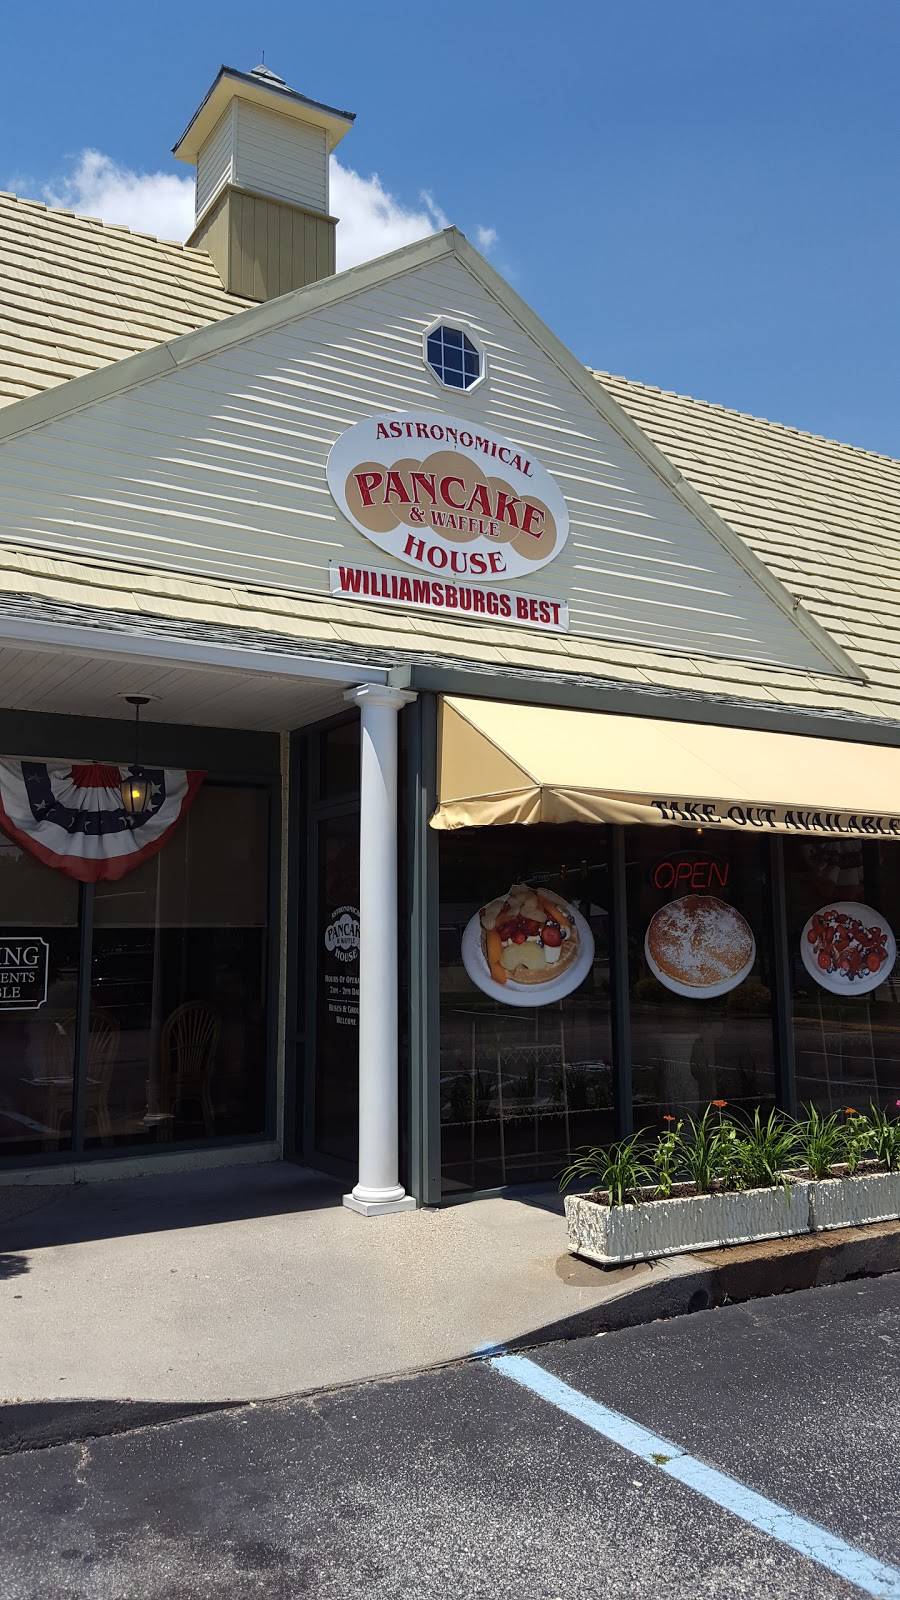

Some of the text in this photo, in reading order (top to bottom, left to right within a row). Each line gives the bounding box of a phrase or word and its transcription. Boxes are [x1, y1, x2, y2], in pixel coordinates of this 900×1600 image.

[376, 421, 534, 478] ASTRONOMICAL
[354, 471, 545, 540] PANCAKE
[409, 506, 499, 537] & WAFFLE
[403, 533, 507, 574] HOUSE
[338, 566, 561, 625] WILLIAMSBURGS BEST
[651, 800, 900, 836] TAKE-OUT AVAILABLE
[654, 862, 729, 889] OPEN
[335, 948, 358, 962] HOUSE
